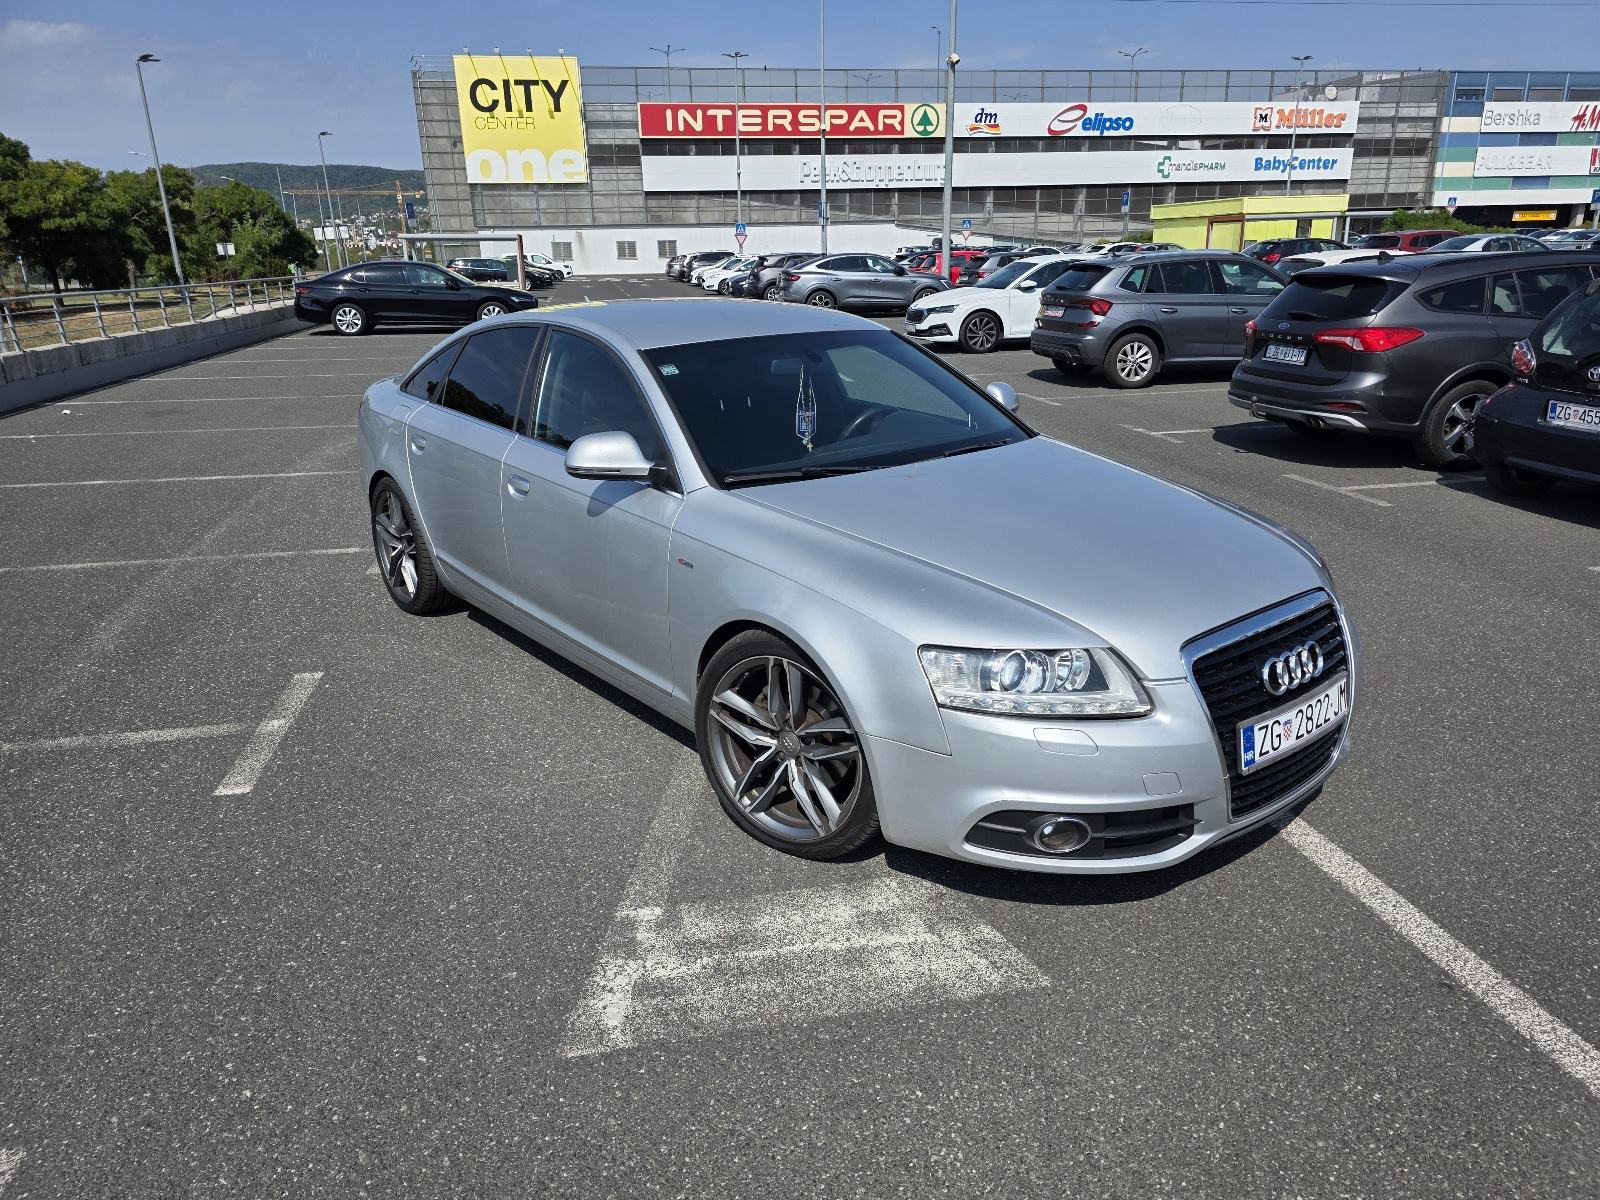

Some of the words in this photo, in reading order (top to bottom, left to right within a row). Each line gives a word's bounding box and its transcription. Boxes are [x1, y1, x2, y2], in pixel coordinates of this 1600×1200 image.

[469, 78, 569, 113] CITY
[474, 117, 536, 130] CENTER
[665, 108, 902, 132] INTERSPAR
[974, 108, 998, 124] dm
[1081, 112, 1134, 135] elipso
[1275, 107, 1347, 129] Müller
[1484, 110, 1541, 126] Bershka
[466, 147, 586, 183] one
[1254, 155, 1338, 174] BabyCenter
[1556, 405, 1572, 421] ZG
[1257, 719, 1282, 758] ZG
[1244, 751, 1254, 762] HR
